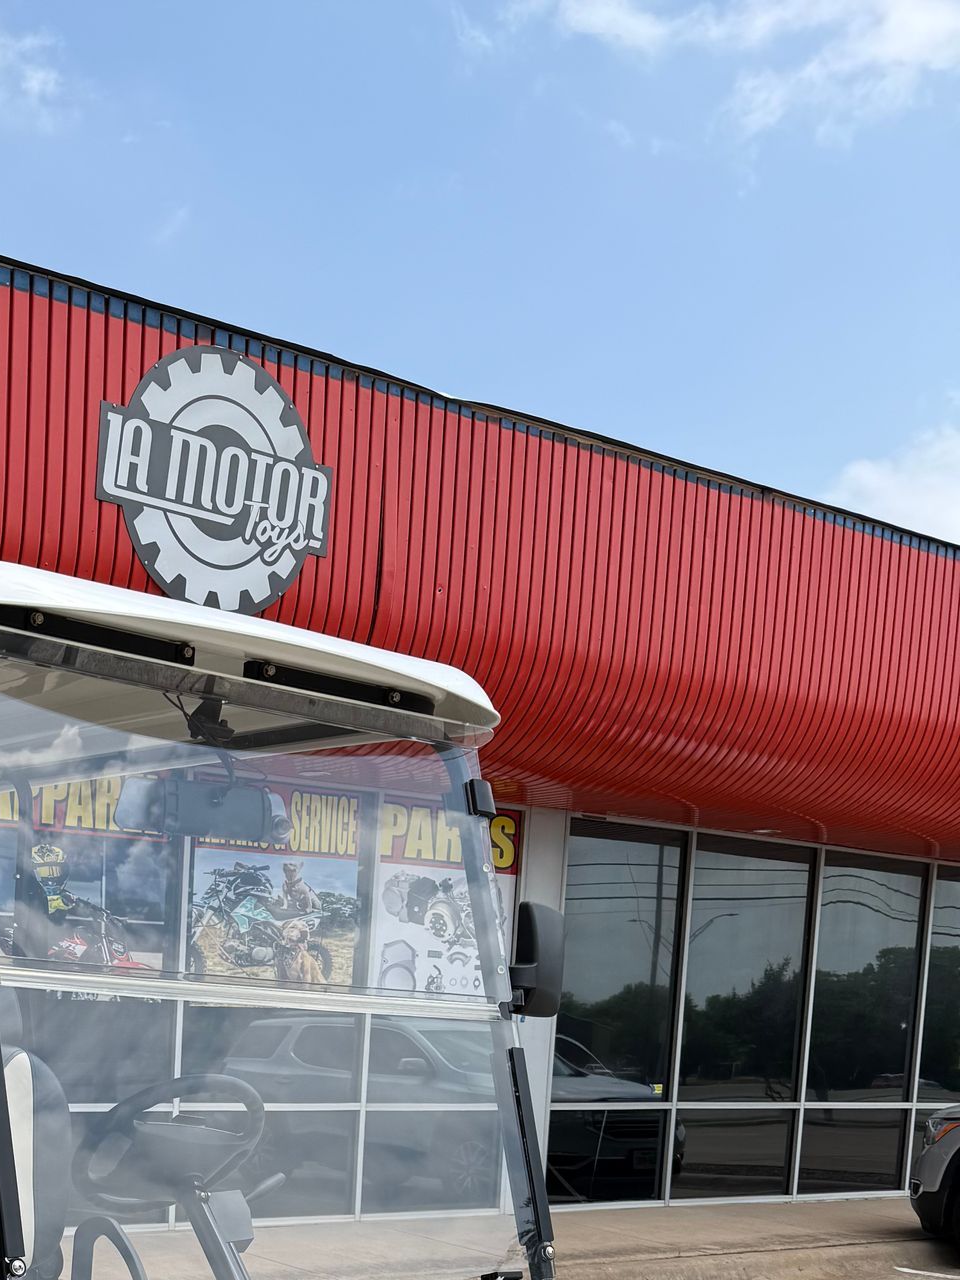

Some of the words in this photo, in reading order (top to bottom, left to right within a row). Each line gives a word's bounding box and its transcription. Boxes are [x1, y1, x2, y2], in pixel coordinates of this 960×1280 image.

[103, 411, 152, 494] LA
[165, 428, 328, 540] MOTOR
[243, 500, 310, 562] Toys
[290, 791, 359, 855] SERVICE
